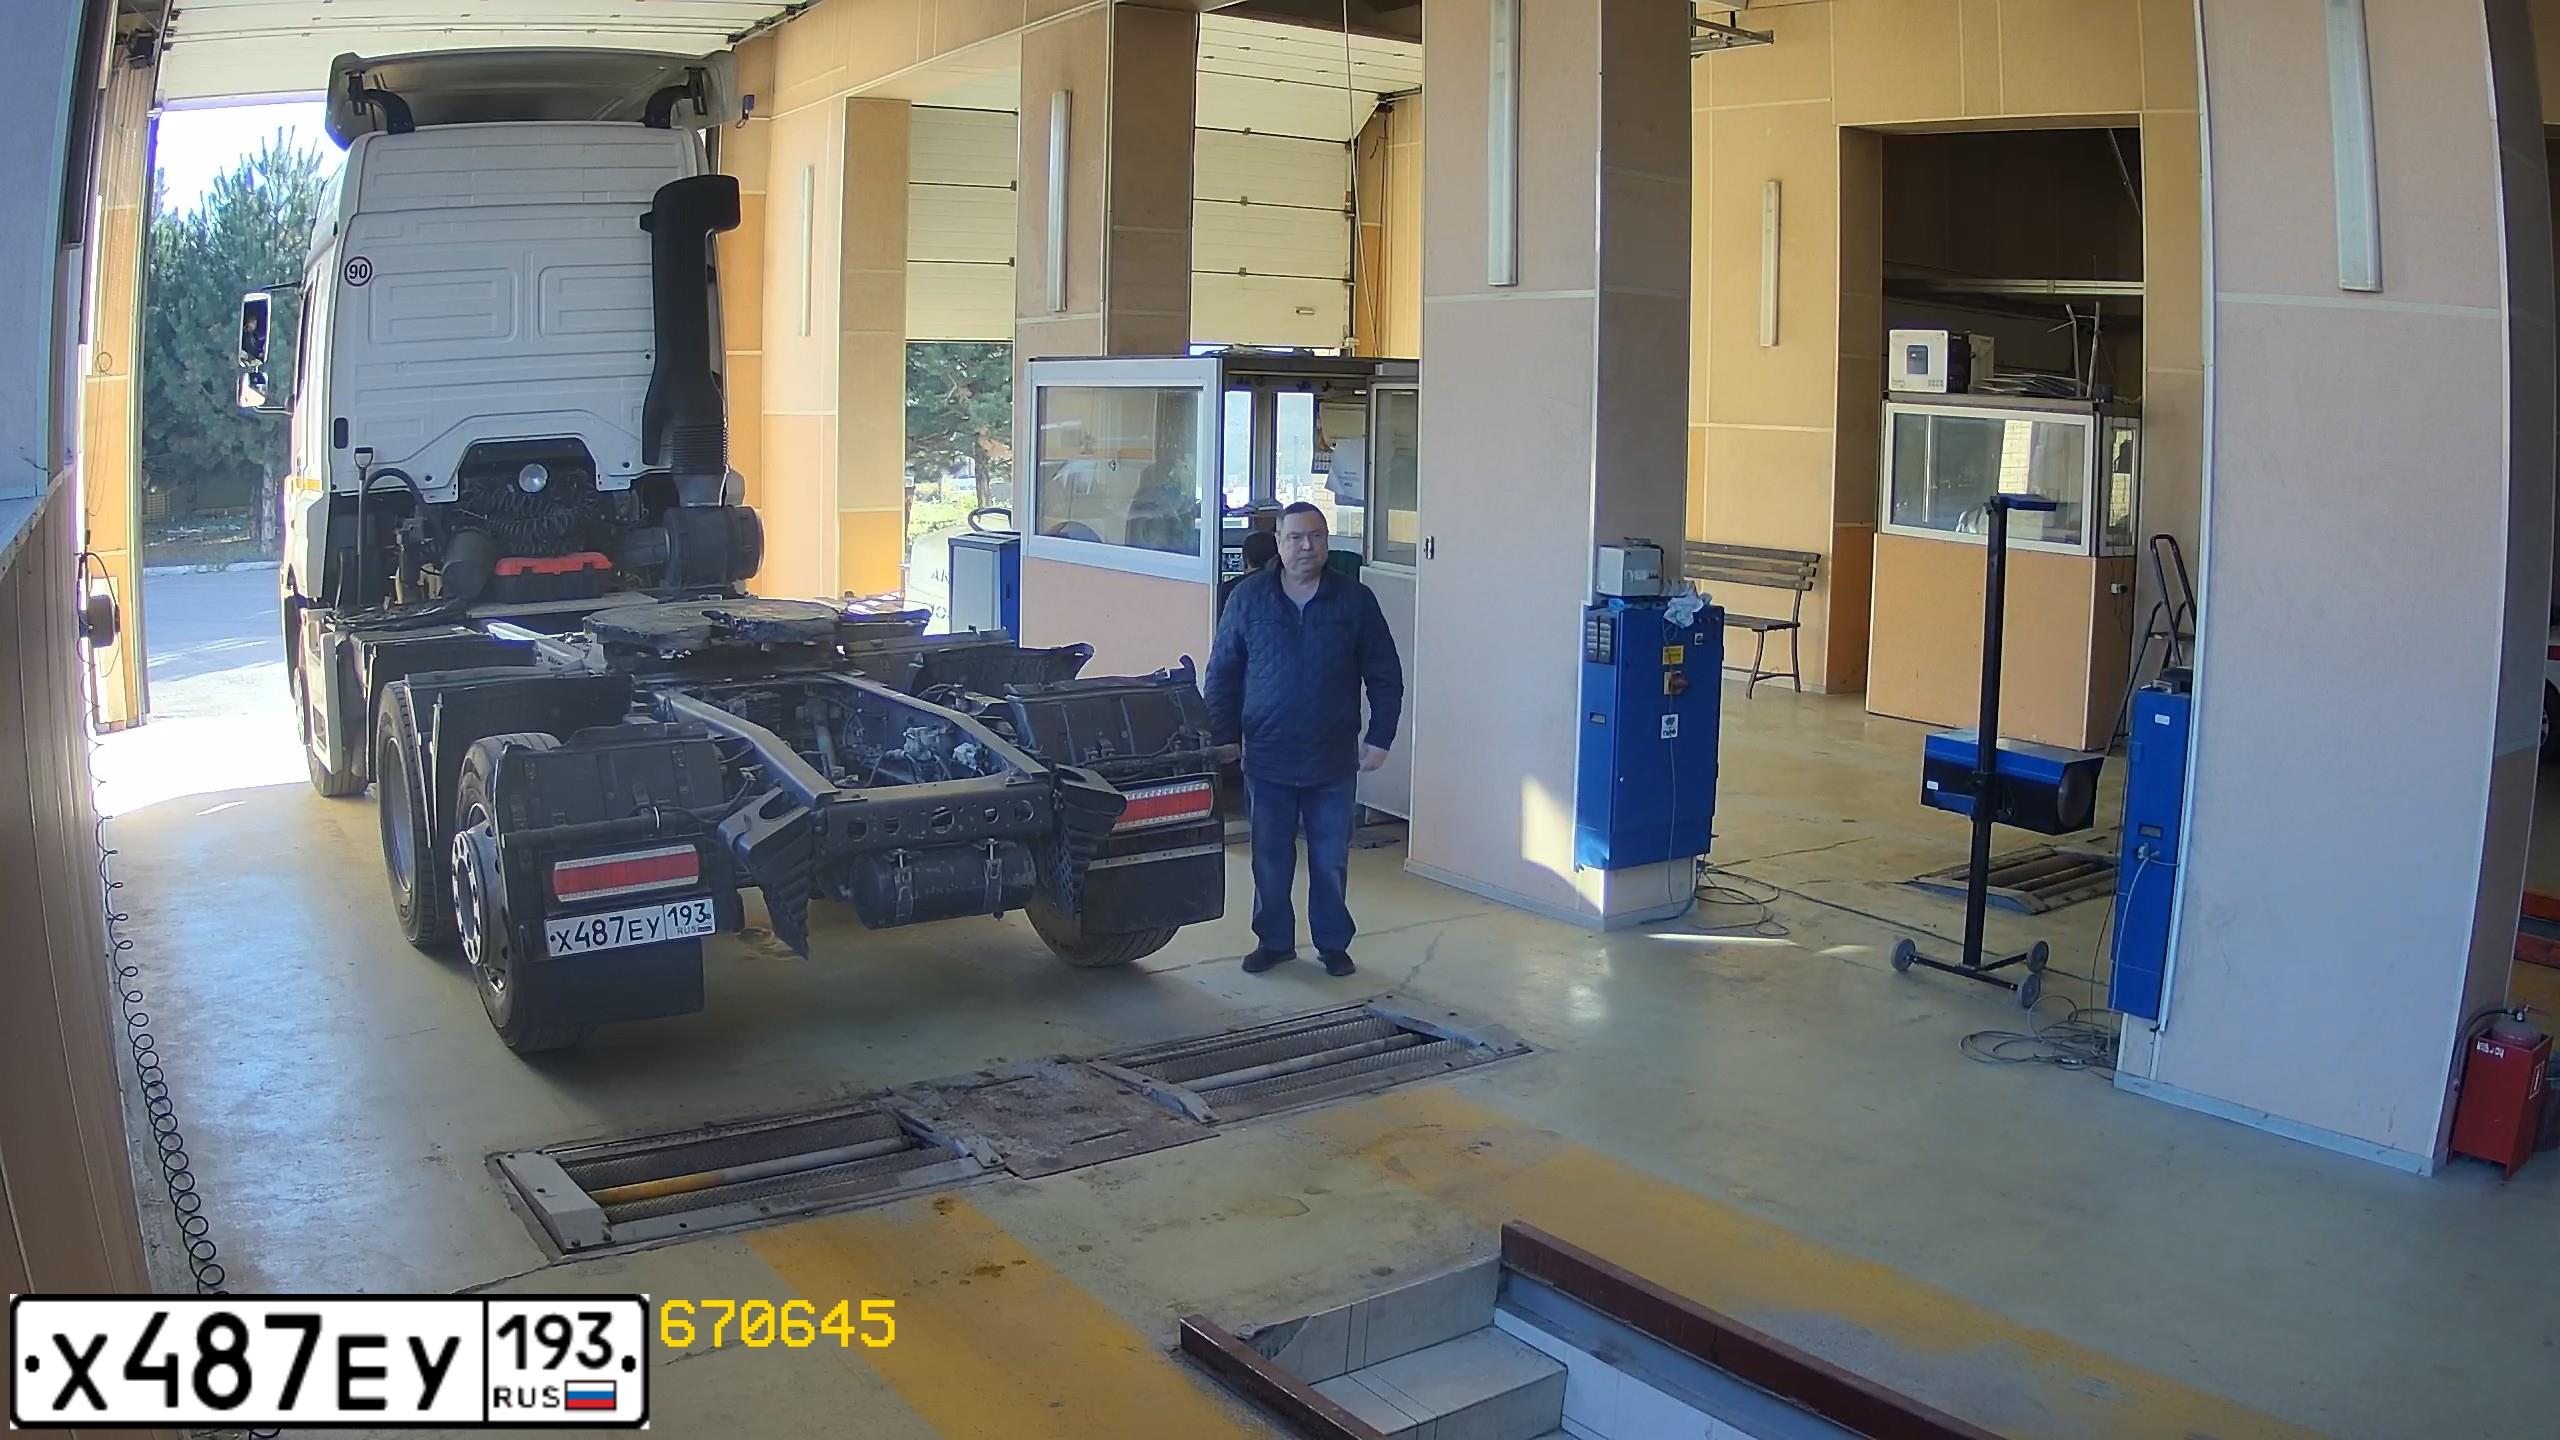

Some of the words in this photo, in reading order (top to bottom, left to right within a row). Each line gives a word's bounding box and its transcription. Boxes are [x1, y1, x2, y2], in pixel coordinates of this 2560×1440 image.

[349, 264, 368, 279] 90
[667, 903, 705, 927] 193
[677, 924, 697, 935] RUS
